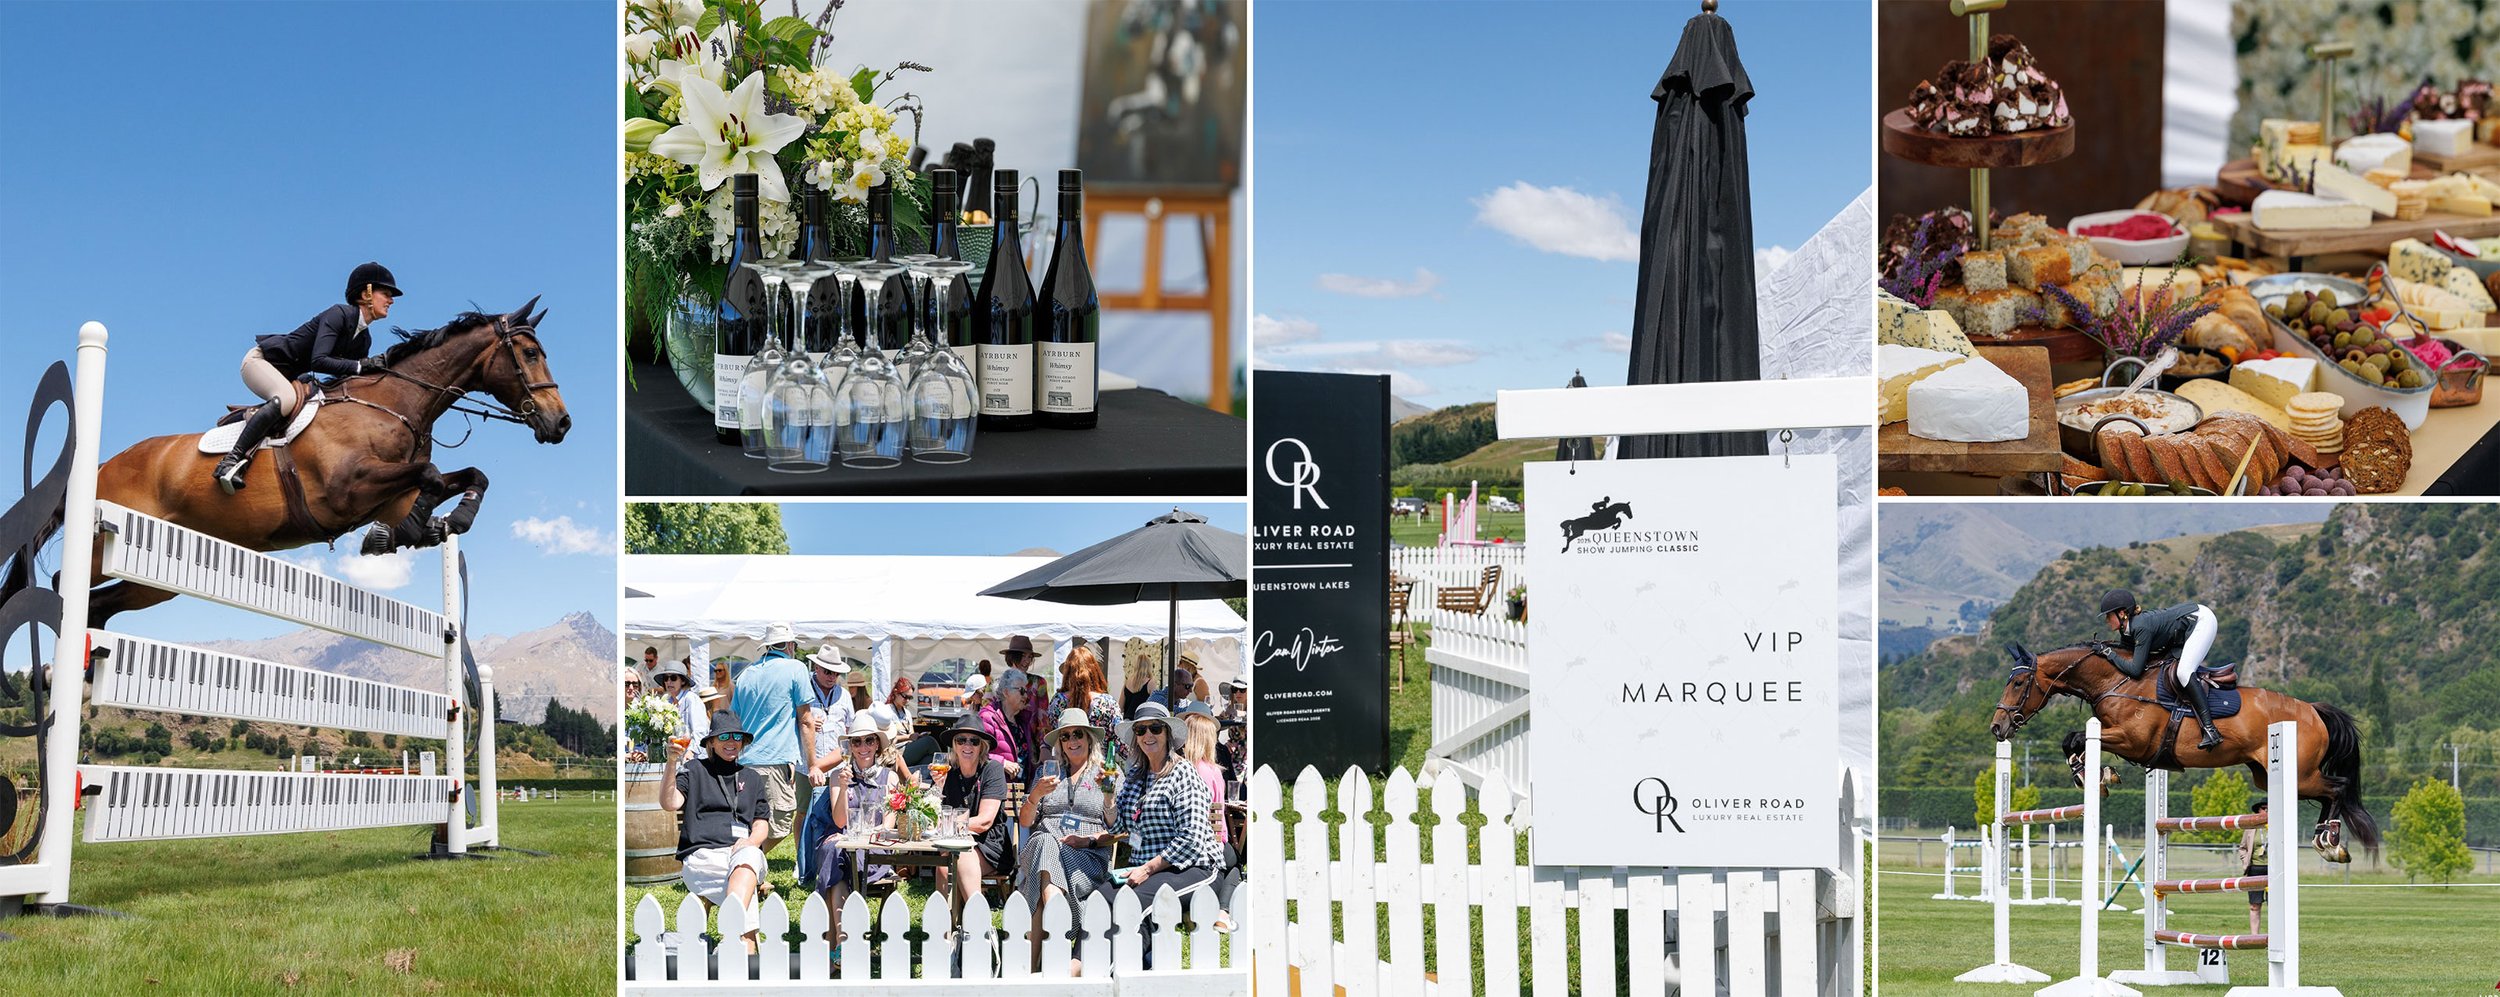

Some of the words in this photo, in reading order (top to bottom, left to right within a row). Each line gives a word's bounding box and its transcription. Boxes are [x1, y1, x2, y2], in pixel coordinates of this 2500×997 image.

[980, 352, 1018, 360] AYRBURN
[987, 364, 1010, 372] Whimsy
[1049, 362, 1072, 370] Whimsy
[1266, 438, 1329, 509] OR
[1254, 526, 1302, 537] LIVER
[1311, 525, 1354, 536] ROAD
[1592, 531, 1699, 545] QUEENSTOWN
[1254, 583, 1315, 591] UEENSTOWN
[1744, 632, 1802, 652] VIP
[1253, 630, 1291, 666] Cam
[1290, 627, 1344, 671] Winter
[1264, 691, 1332, 699] OLIVERROAD.COM
[1623, 682, 1801, 705] MARQUEE
[1634, 778, 1685, 833] OR
[1692, 799, 1751, 808] OLIVER
[1760, 799, 1804, 808] ROAD
[2201, 948, 2219, 966] 12
